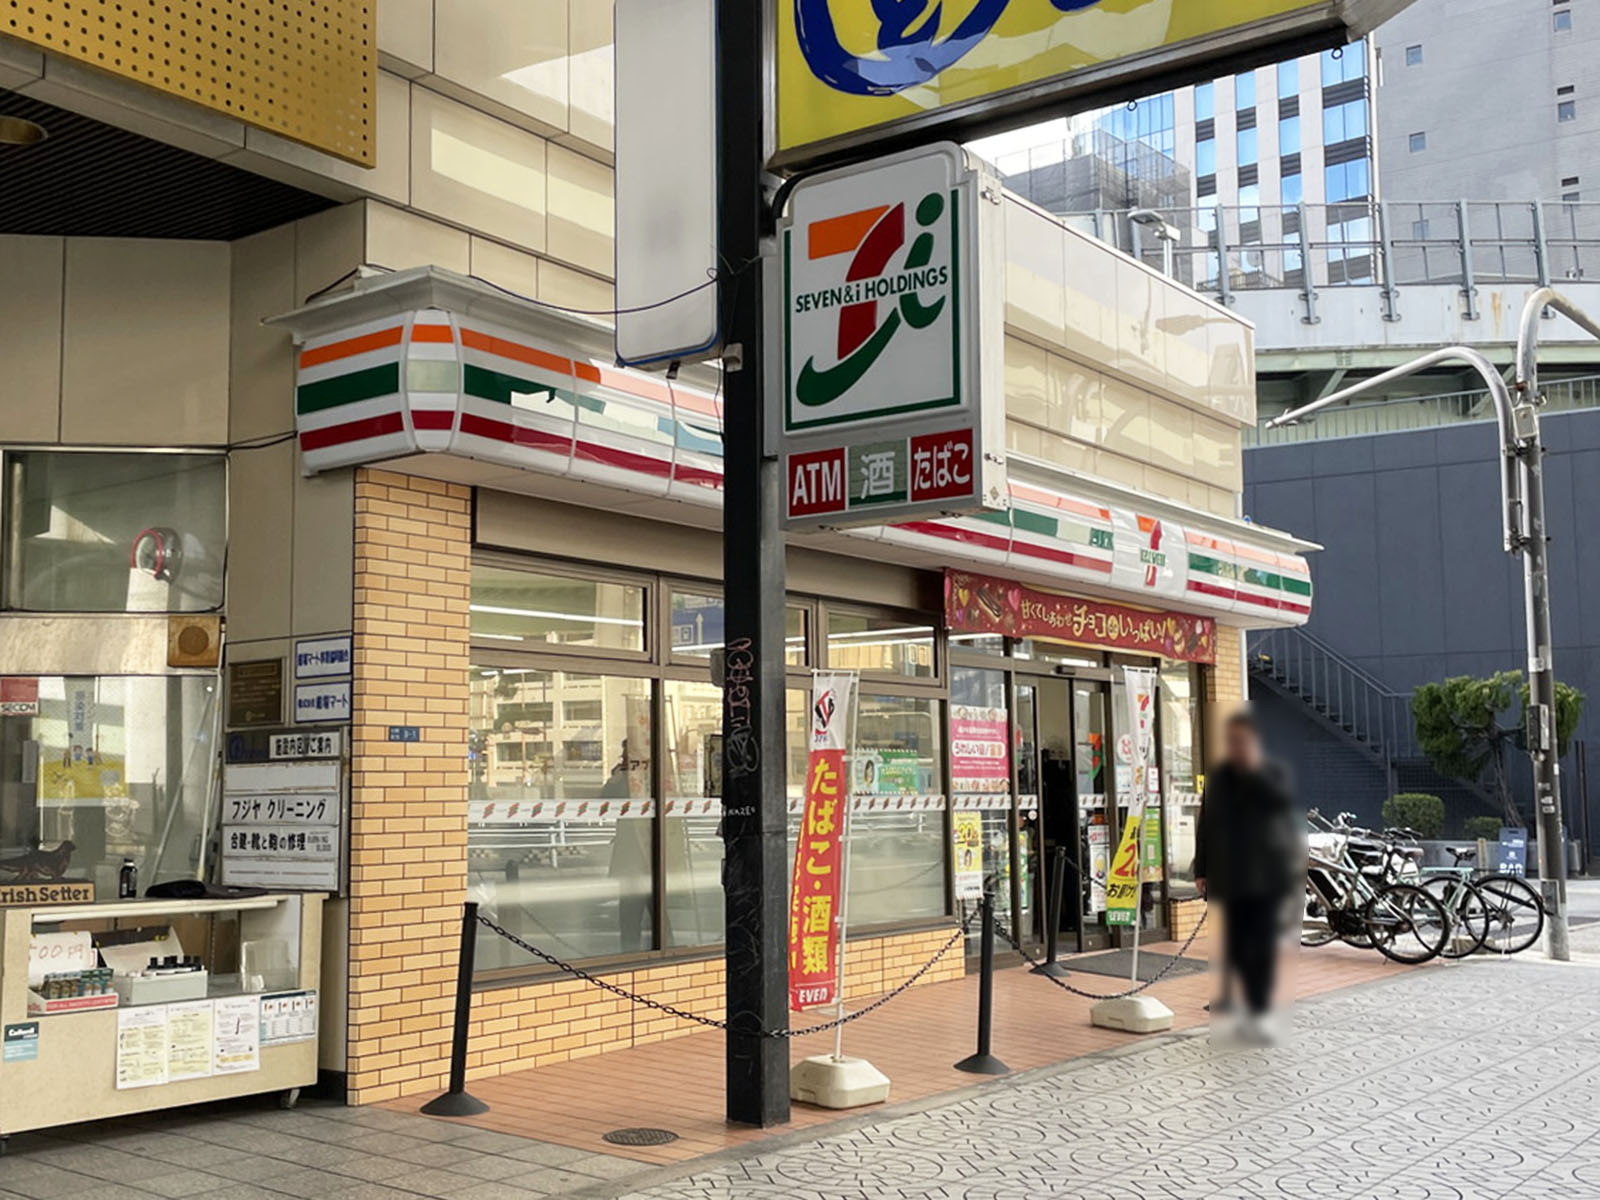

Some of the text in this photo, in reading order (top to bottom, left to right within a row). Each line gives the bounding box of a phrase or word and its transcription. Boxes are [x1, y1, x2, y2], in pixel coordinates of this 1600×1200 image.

[795, 265, 948, 314] SEVEN&i HOLDINGS
[793, 459, 842, 506] ATM
[861, 452, 895, 499] 酒
[914, 440, 970, 491] たばこ
[232, 798, 327, 820] フジヤ クリーニング
[803, 758, 838, 976] たばこ・酒類
[0, 886, 89, 903] rish Setter
